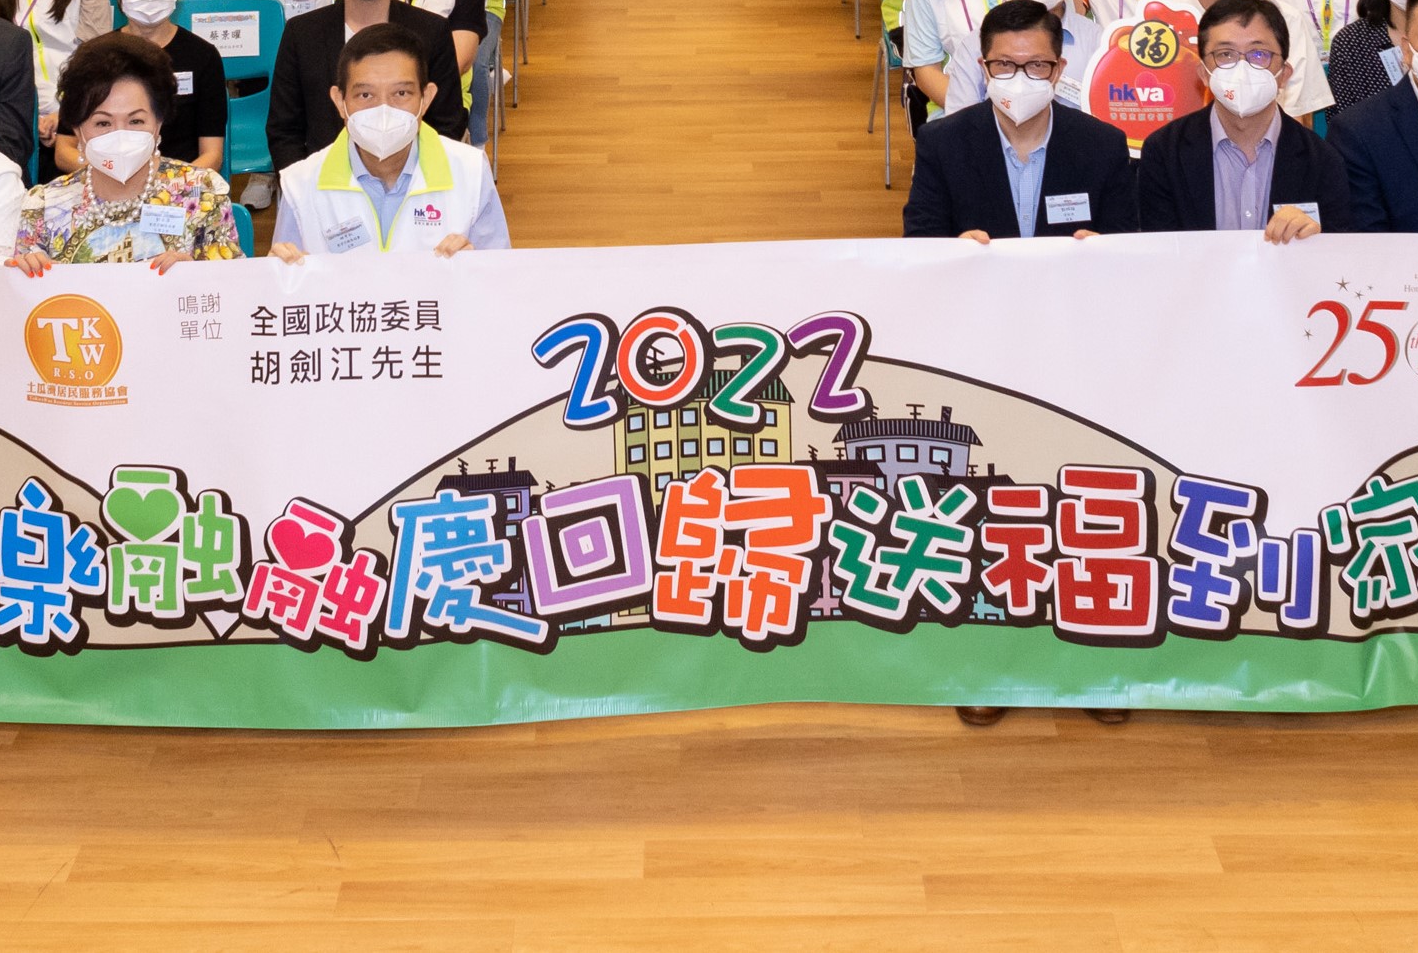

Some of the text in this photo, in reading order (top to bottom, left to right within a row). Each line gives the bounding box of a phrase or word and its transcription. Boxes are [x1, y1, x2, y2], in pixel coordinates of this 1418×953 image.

[1135, 25, 1170, 63] 福
[1109, 83, 1165, 102] hkva
[414, 208, 437, 219] hkva
[178, 292, 221, 315] 鳴謝
[250, 299, 442, 338] 全國政協委員
[179, 319, 222, 341] 單位
[1294, 300, 1410, 387] 25
[249, 343, 444, 386] 胡劍江先生
[532, 306, 873, 431] 2022
[27, 381, 129, 400] 土瓜灣居民服務協會
